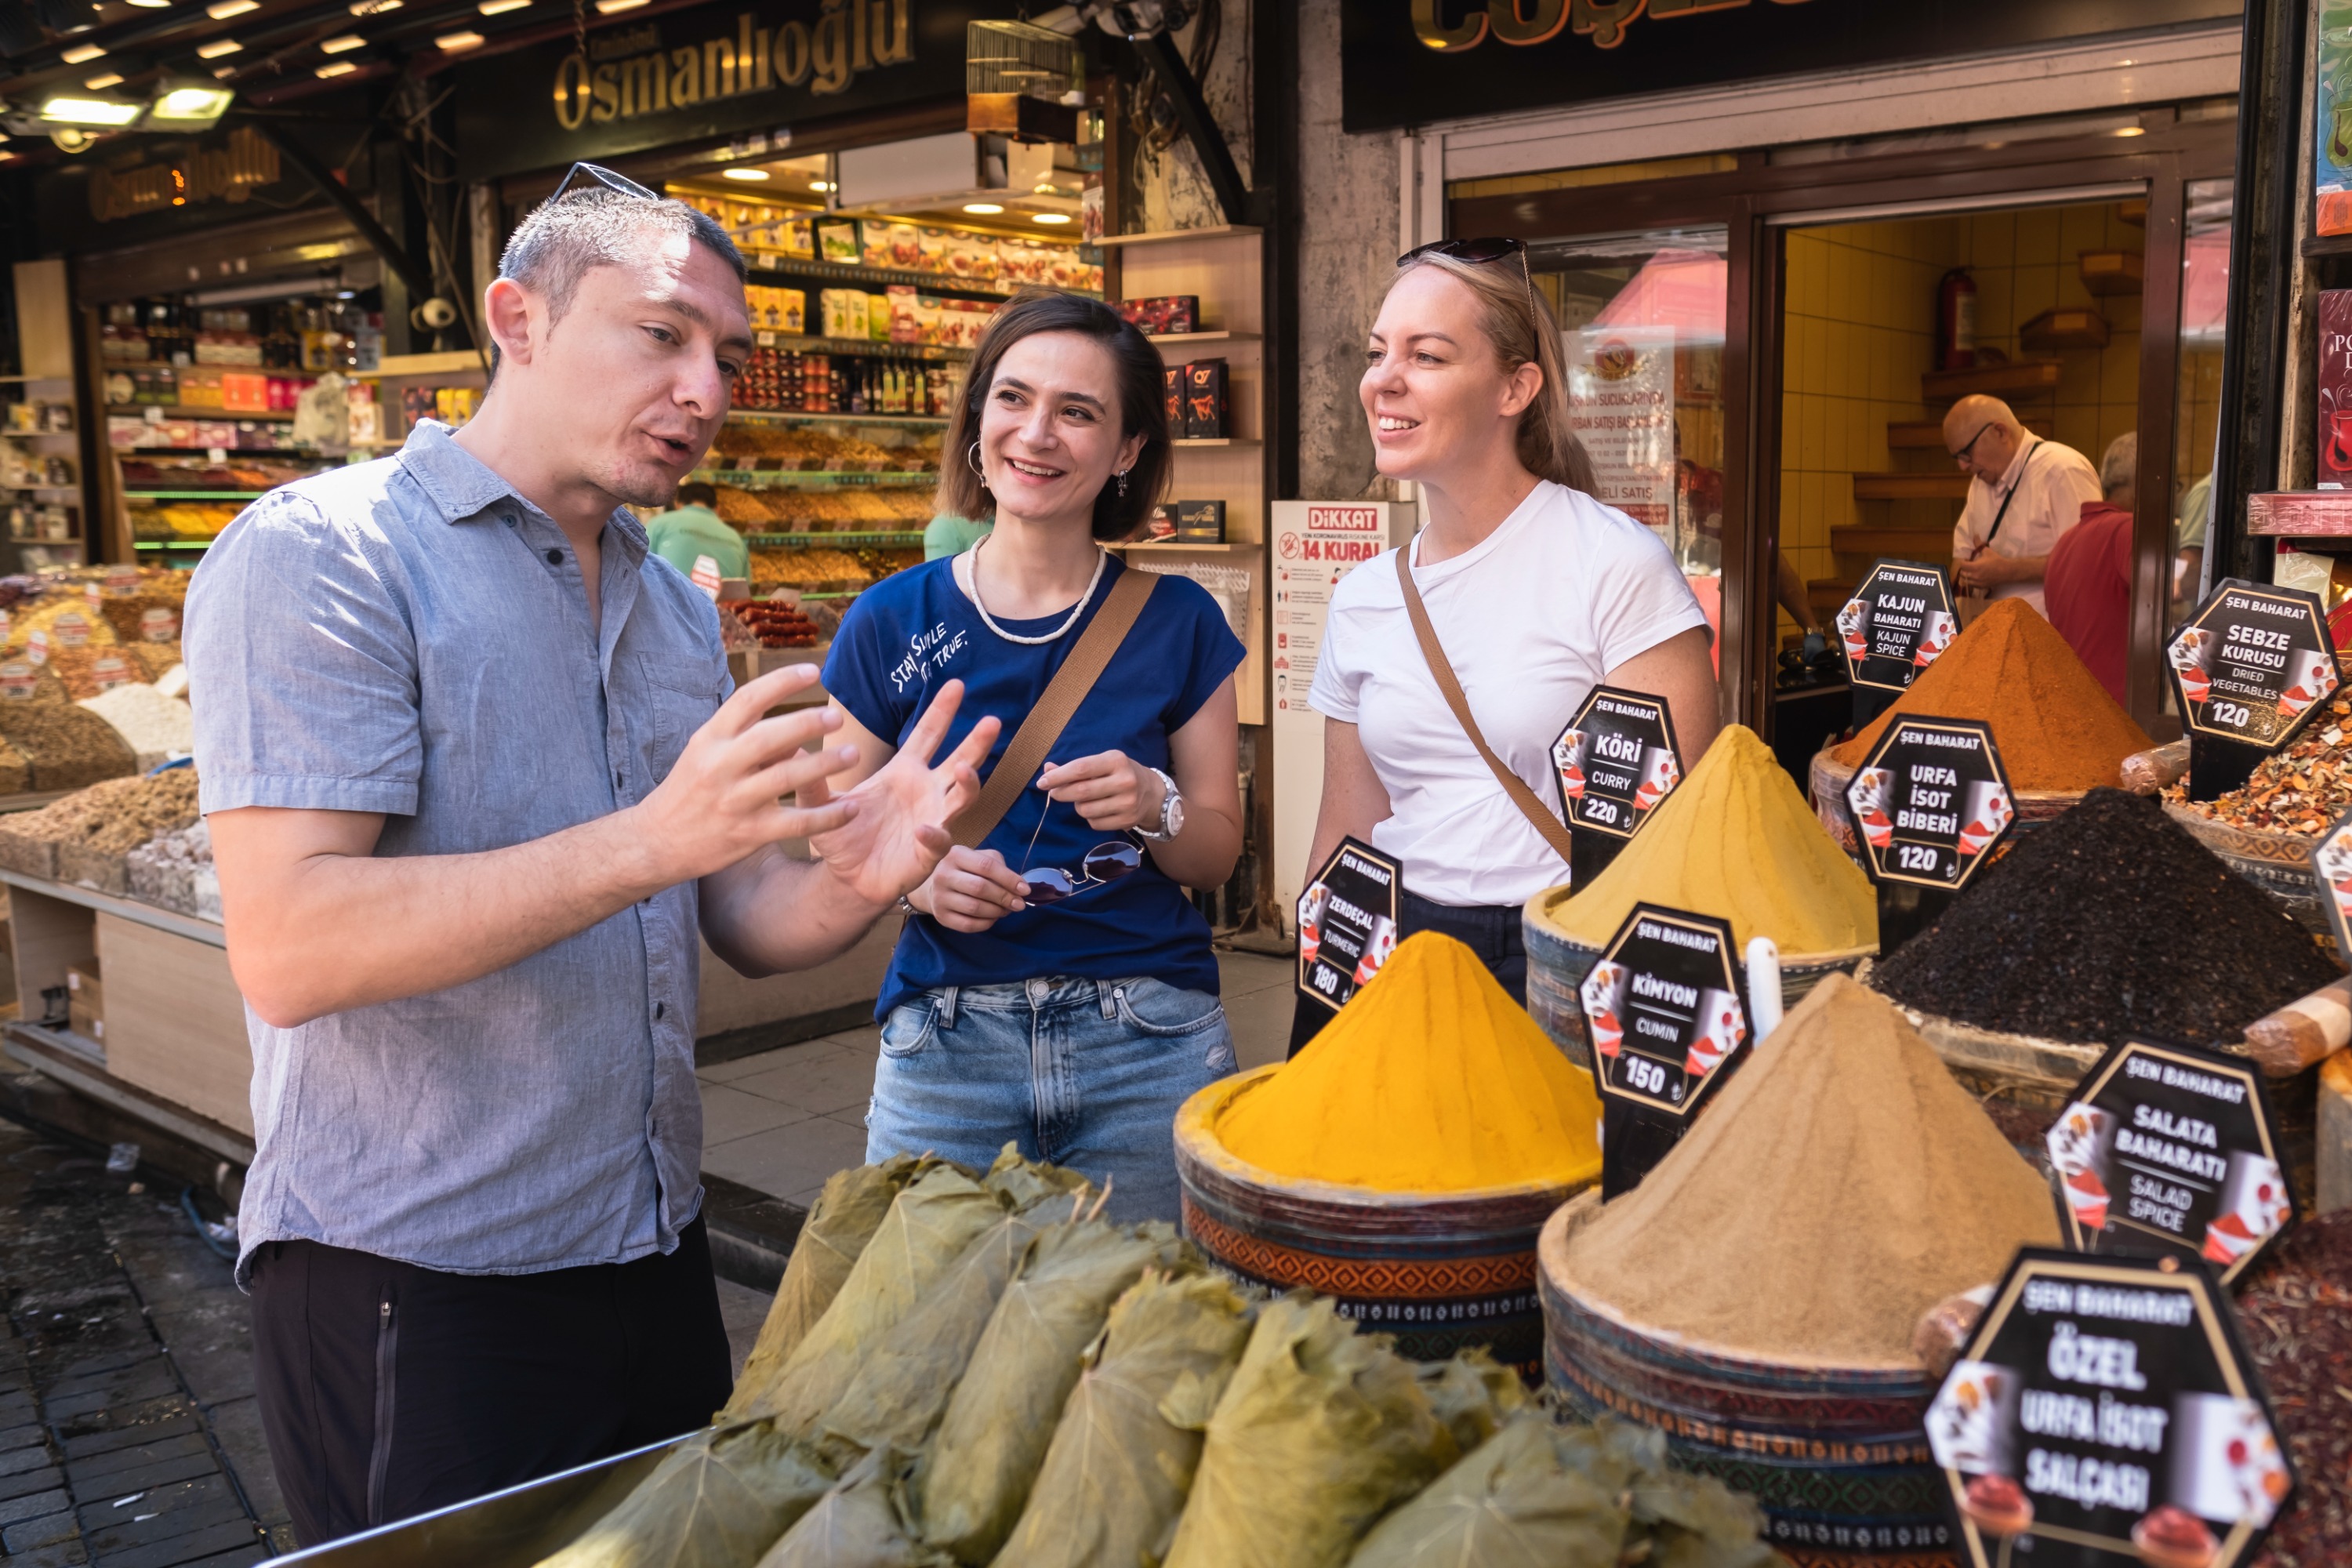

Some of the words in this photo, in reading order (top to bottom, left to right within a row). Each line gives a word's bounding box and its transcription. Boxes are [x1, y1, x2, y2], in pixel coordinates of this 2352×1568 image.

[1622, 486, 1653, 499] SATIŞ
[1302, 539, 1321, 561] 14
[1878, 572, 1895, 582] ŞEN
[1896, 574, 1936, 586] BAHARAT
[1878, 594, 1926, 613] KAJUN
[2226, 597, 2249, 609] ŞEN
[2251, 601, 2307, 619] BAHARAT
[1874, 613, 1922, 628] BAHARATI
[932, 630, 968, 667] TRUE.
[1876, 643, 1906, 657] SPICE
[1877, 630, 1911, 644] KAJUN
[2227, 625, 2291, 651] SEBZE
[2222, 644, 2286, 668] KURUSU
[891, 652, 920, 693] STAY
[2232, 668, 2264, 682] DRIED
[2212, 678, 2278, 700] VEGETABLES
[1596, 699, 1615, 712] ŞEN
[1615, 703, 1657, 720] BAHARAT
[2212, 702, 2249, 728] 120
[1595, 732, 1643, 763] KÖRİ
[1900, 731, 1924, 745] ŞEN
[1926, 734, 1980, 750] BAHARAT
[1592, 771, 1632, 791] CURRY
[1911, 764, 1957, 786] URFA
[1910, 785, 1951, 809] İSOT
[1585, 798, 1617, 824] 220
[1896, 808, 1958, 834] BİBERİ
[1341, 853, 1356, 870] ŞEN
[1356, 858, 1392, 886] BAHARAT
[1899, 846, 1937, 871] 120
[1328, 895, 1374, 931] ZERDEÇAL
[1323, 928, 1361, 959] TURMERIC
[1637, 921, 1661, 939] ŞEN
[1661, 927, 1719, 953] BAHARAT
[1313, 964, 1338, 995] 180
[1632, 971, 1698, 1008] KİMYON
[1635, 1017, 1679, 1043] CUMIN
[1625, 1055, 1666, 1094] 150
[2125, 1056, 2161, 1081] ŞEN
[2161, 1065, 2246, 1104] BAHARAT
[2132, 1104, 2217, 1149] SALATA
[2114, 1127, 2227, 1182] BAHARATI
[2129, 1174, 2193, 1211] SALAD
[2128, 1196, 2186, 1232] SPICE
[2023, 1280, 2074, 1315] ŞEN
[2074, 1284, 2194, 1327] BAHARAT
[2047, 1320, 2147, 1392] ÖZEL
[2020, 1388, 2096, 1443] URFA
[2096, 1389, 2169, 1454] İSOT
[2024, 1447, 2151, 1513] SALÇASI
